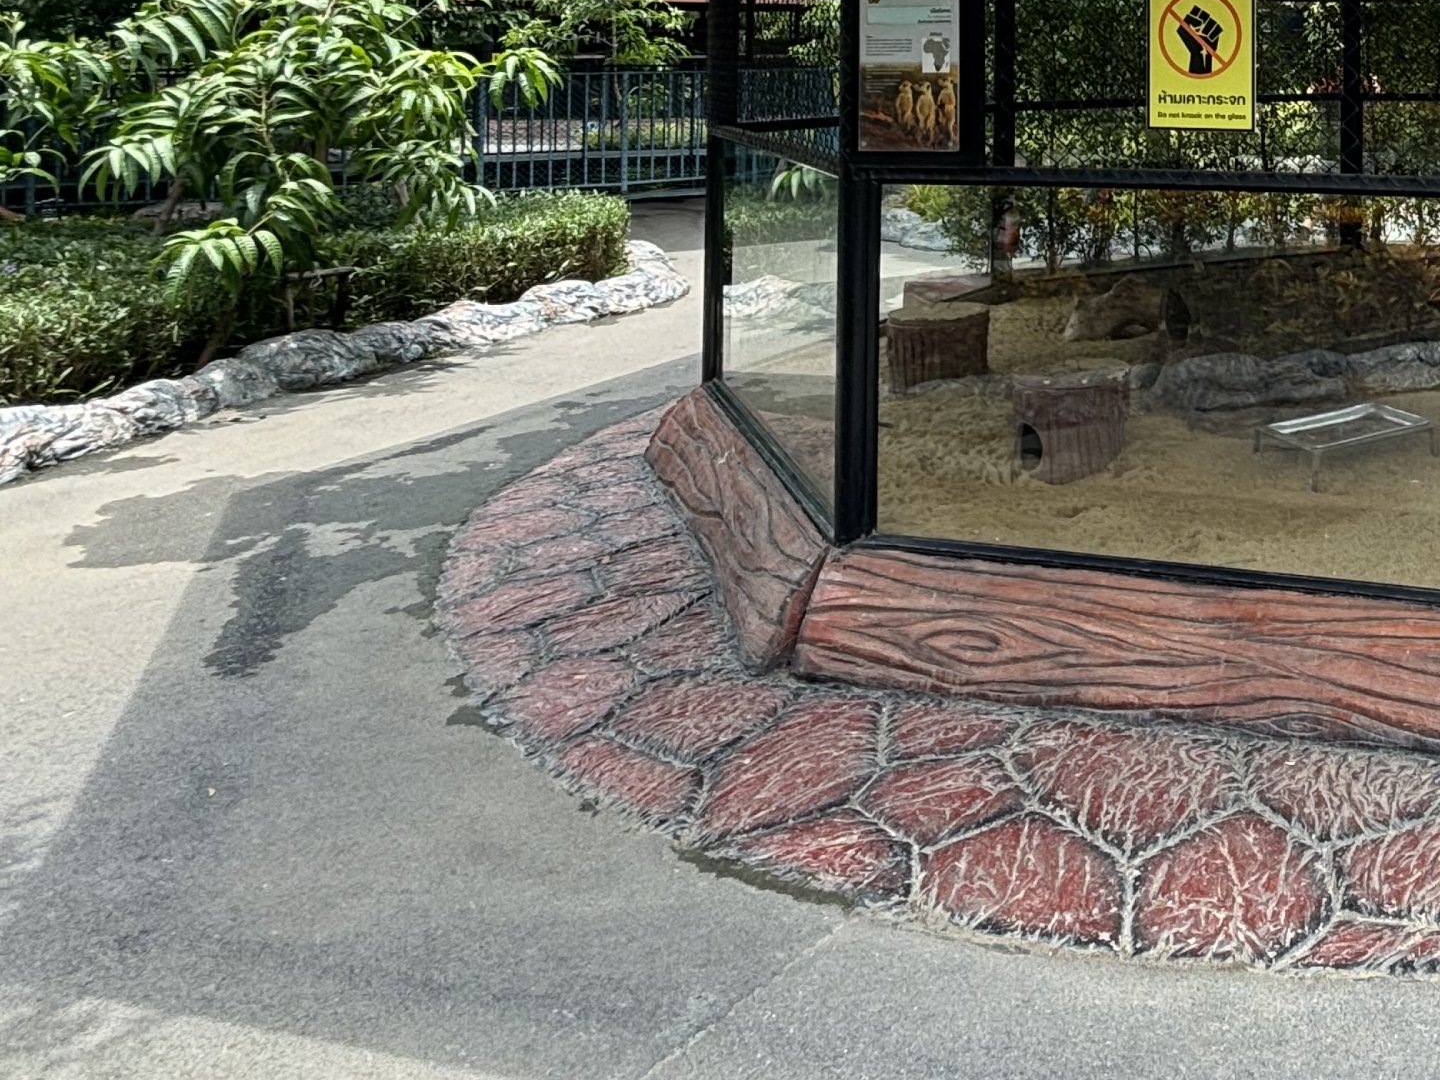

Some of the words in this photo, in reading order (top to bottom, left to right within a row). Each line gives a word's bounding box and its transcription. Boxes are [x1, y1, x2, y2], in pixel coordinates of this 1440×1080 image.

[1158, 90, 1246, 106] ห้ามเคาะกระจก
[1181, 111, 1202, 119] knock
[1214, 112, 1226, 120] the
[1227, 113, 1246, 121] glass
